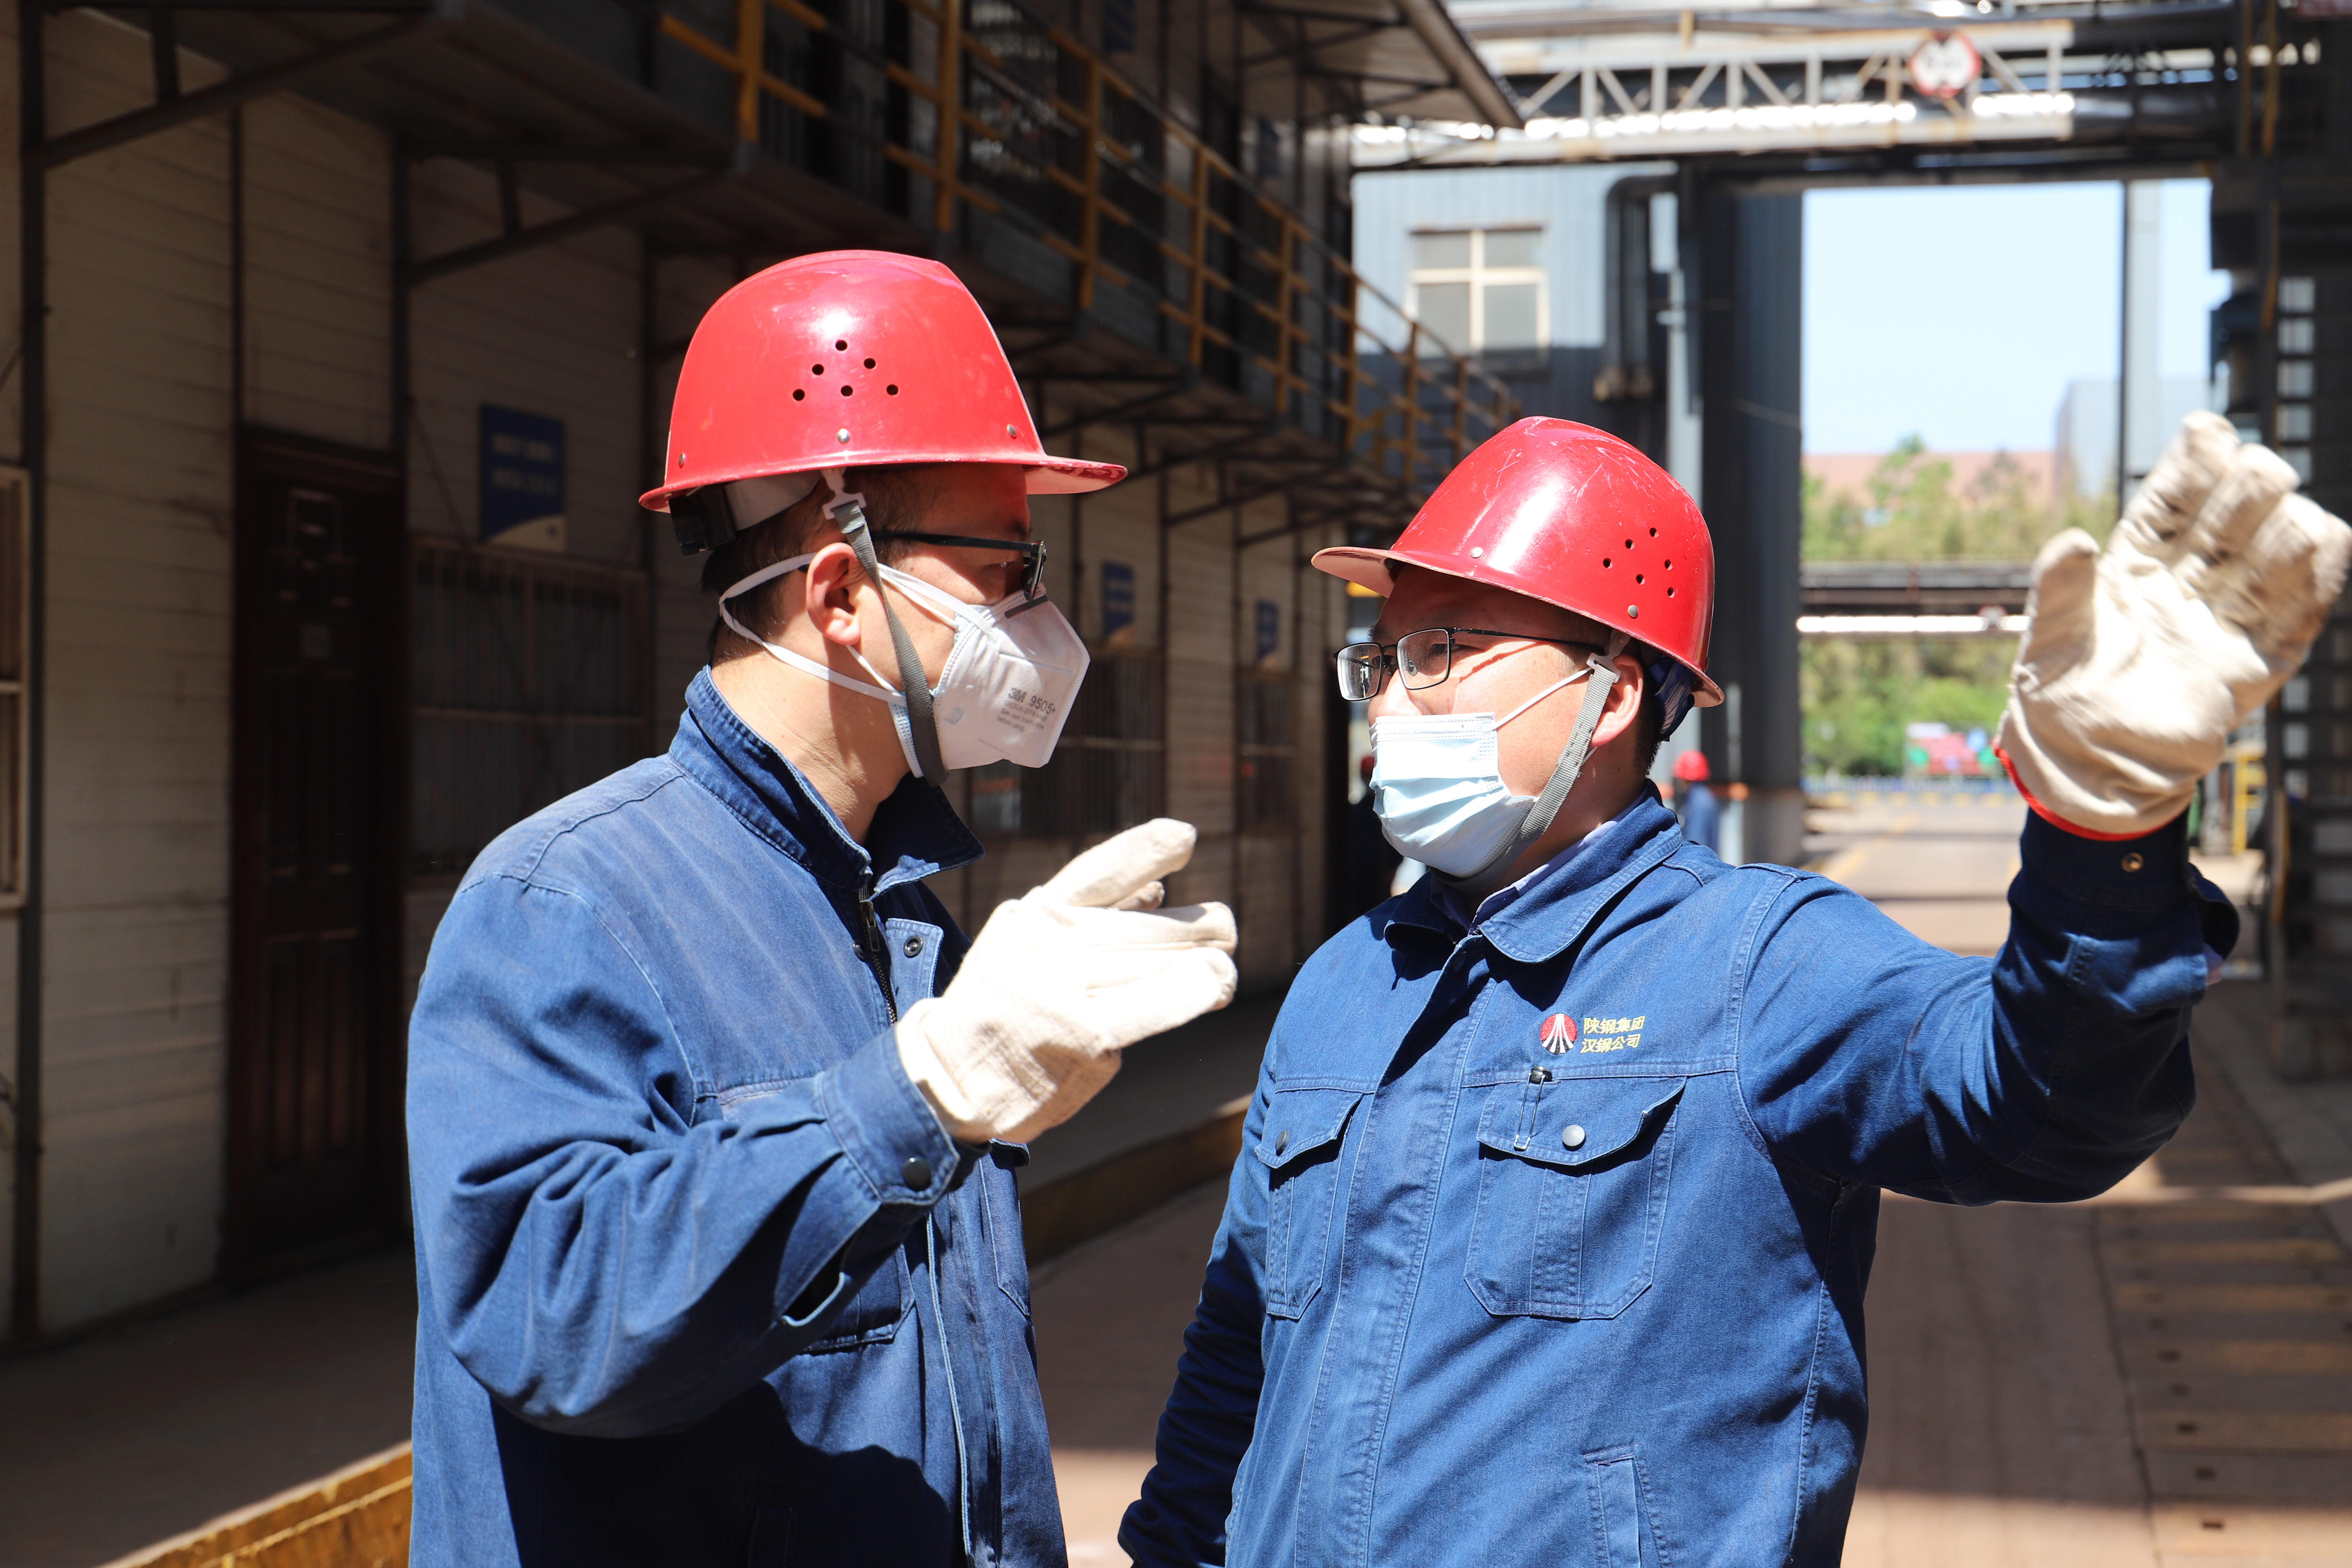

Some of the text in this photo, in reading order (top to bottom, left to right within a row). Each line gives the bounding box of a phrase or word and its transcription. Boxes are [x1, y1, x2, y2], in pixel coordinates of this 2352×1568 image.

[1009, 688, 1056, 715] 3M 9505+
[1001, 708, 1010, 716] See
[997, 716, 1025, 733] before using
[1583, 1016, 1645, 1034] 陕钢集团
[1580, 1034, 1641, 1054] 汉钢公司
